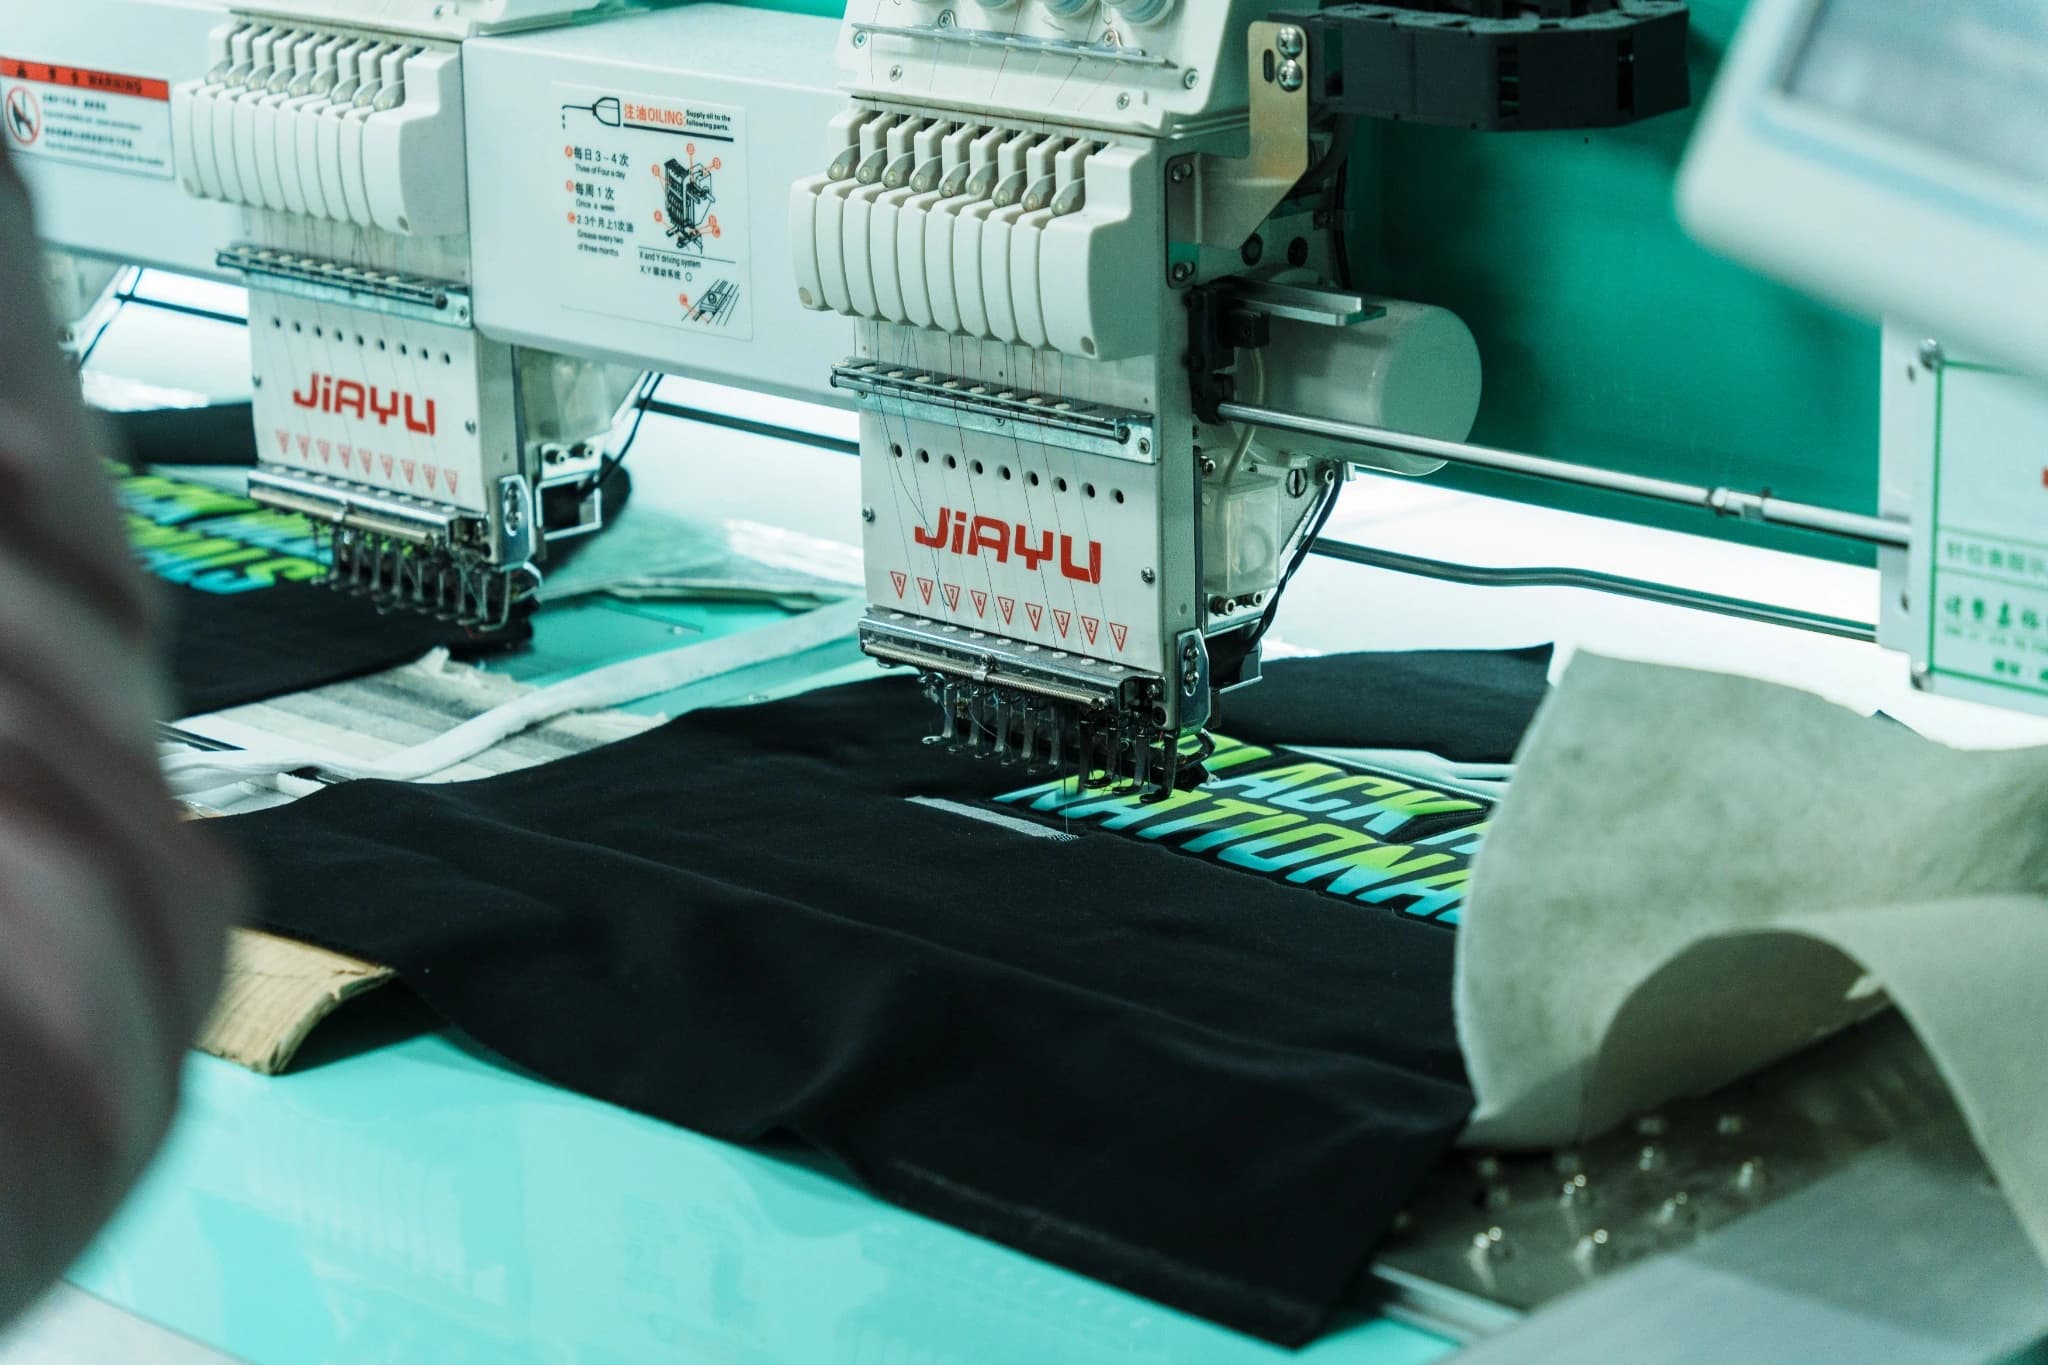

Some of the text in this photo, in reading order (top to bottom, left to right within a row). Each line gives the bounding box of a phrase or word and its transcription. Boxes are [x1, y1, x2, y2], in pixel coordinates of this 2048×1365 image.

[686, 109, 705, 120] Supply
[721, 113, 731, 122] the
[686, 119, 713, 130] following
[576, 198, 591, 209] Once
[991, 768, 1472, 925] NATIONA
